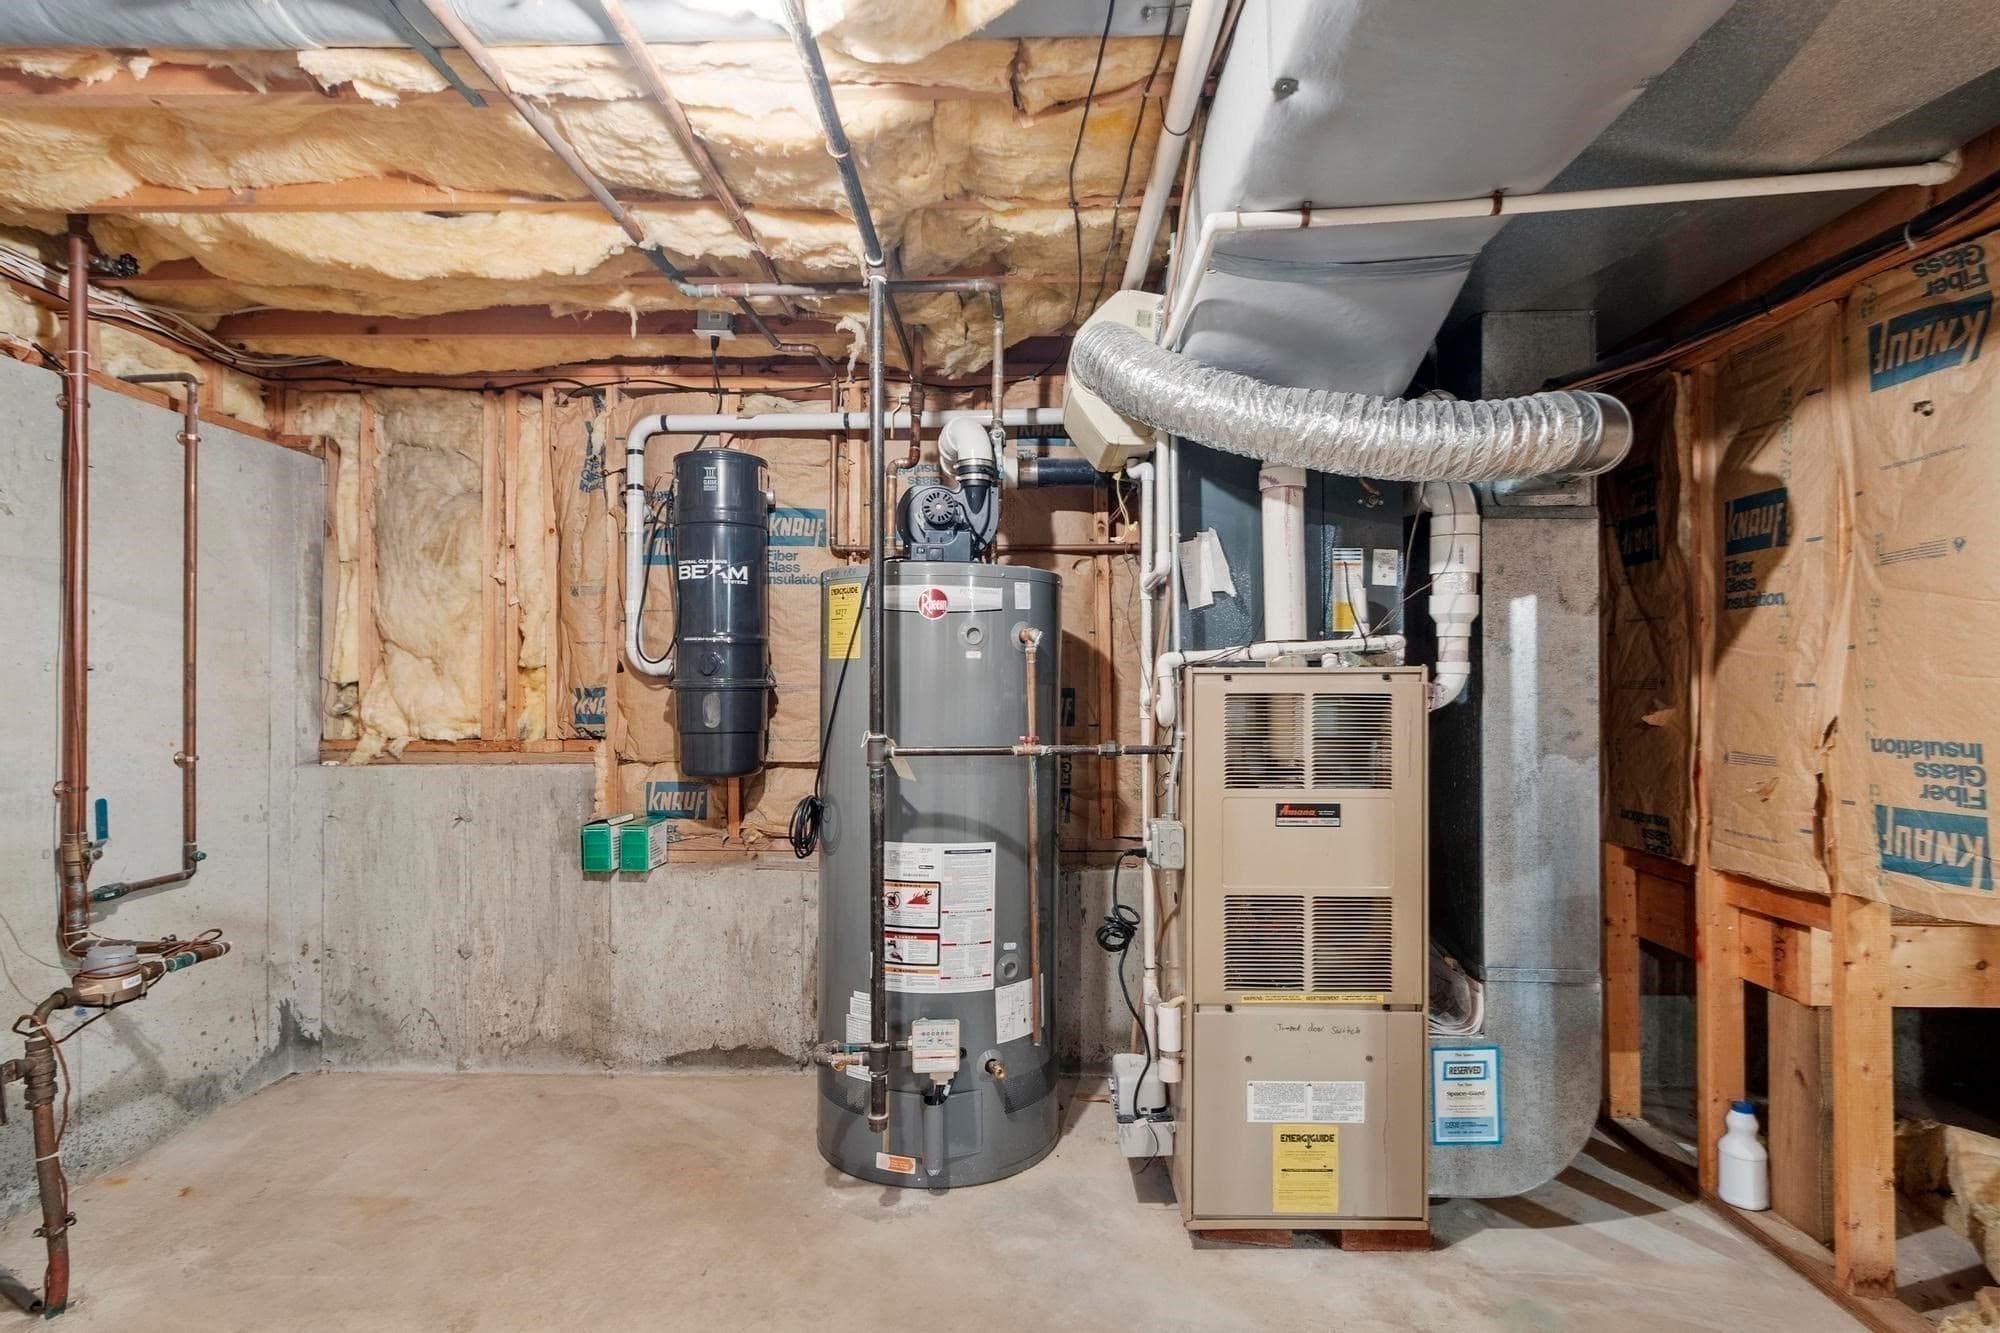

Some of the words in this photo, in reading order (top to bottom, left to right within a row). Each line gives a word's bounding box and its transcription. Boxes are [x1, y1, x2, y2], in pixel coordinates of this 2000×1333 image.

[1911, 244, 1985, 278] Glass
[1925, 263, 1989, 296] Fiber
[1873, 310, 1987, 375] KNAUF
[769, 512, 825, 547] KNAUF
[1726, 500, 1785, 547] KNAUF
[678, 564, 749, 580] BEAM
[764, 574, 819, 585] Insulatio
[920, 588, 948, 616] Rheem
[1870, 738, 1985, 765] Insulation
[1913, 761, 1988, 788] Glass
[648, 782, 706, 820] KNAUF
[1279, 803, 1318, 817] Amana
[1919, 784, 1988, 810] Fiber
[1882, 806, 1985, 889] KNAUF
[1448, 1065, 1482, 1075] RESERVED
